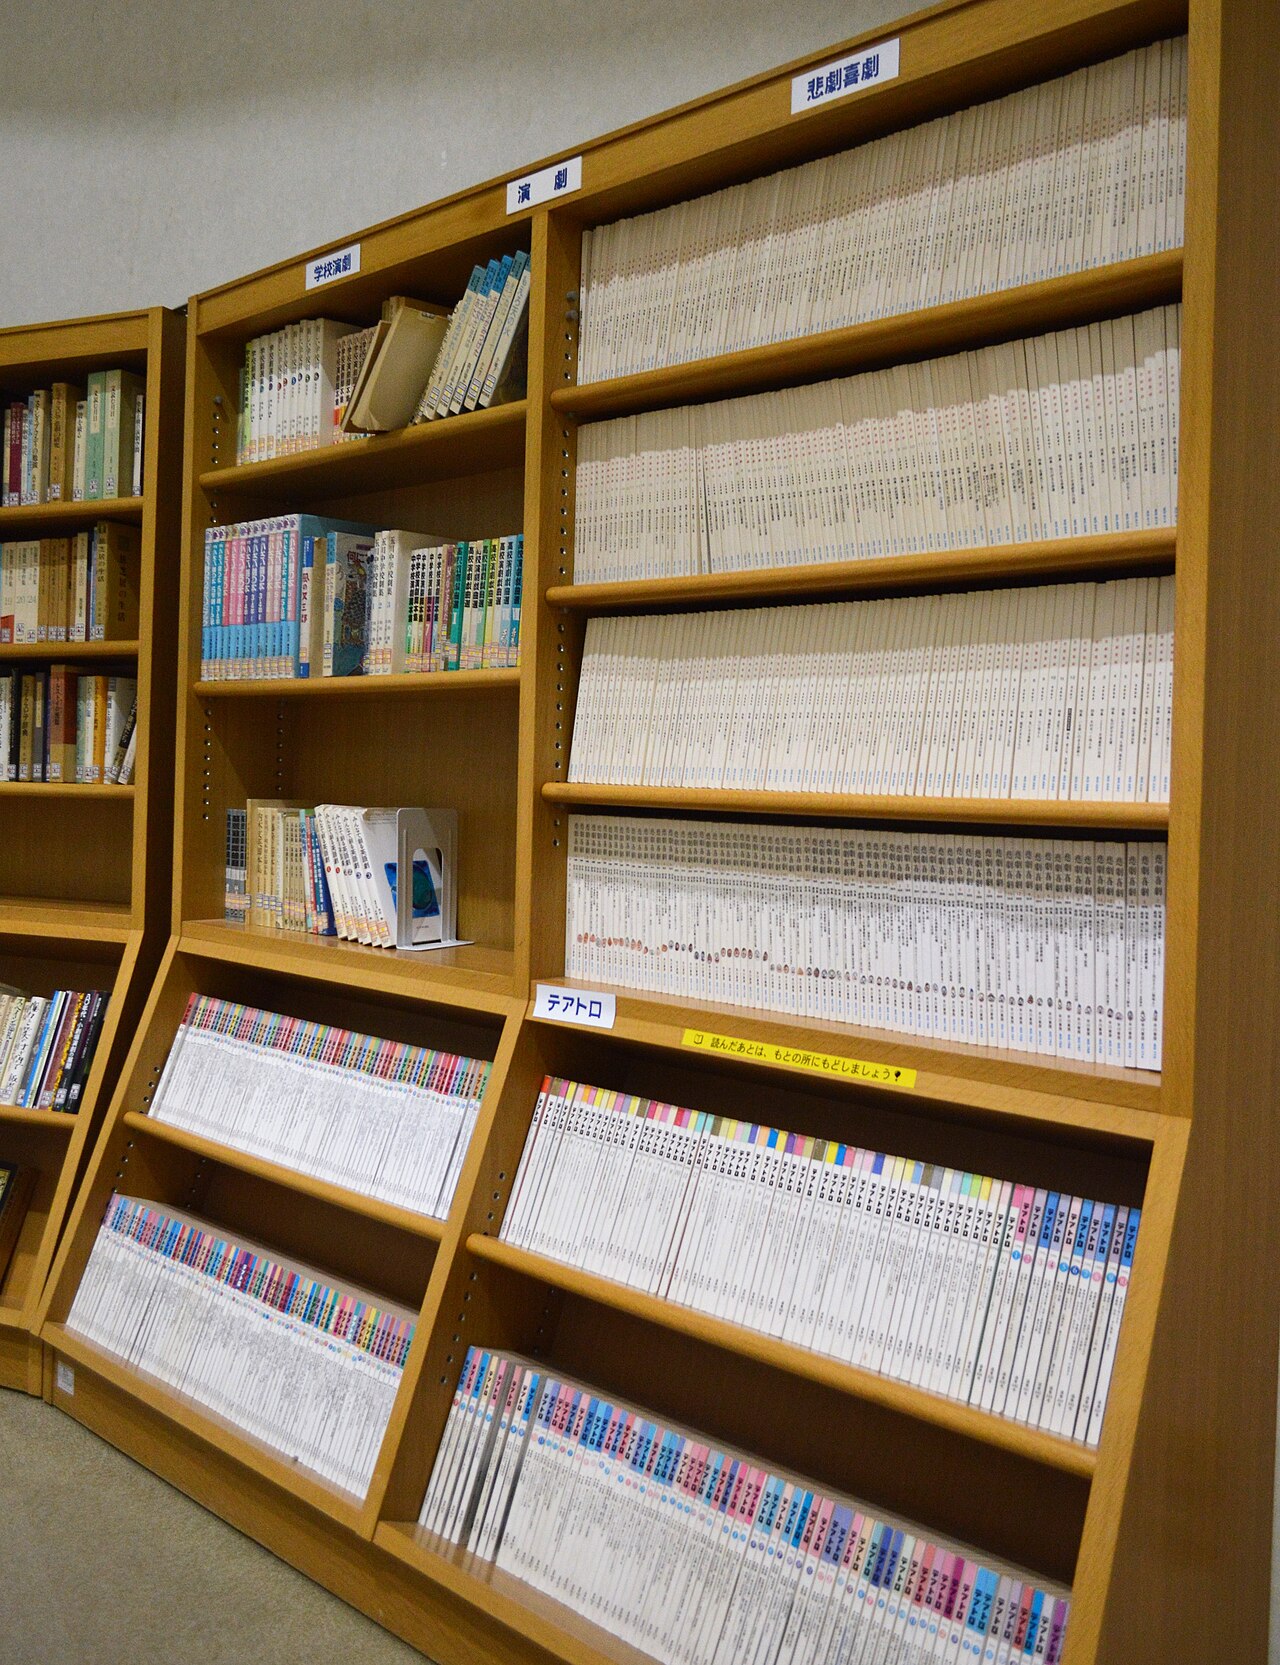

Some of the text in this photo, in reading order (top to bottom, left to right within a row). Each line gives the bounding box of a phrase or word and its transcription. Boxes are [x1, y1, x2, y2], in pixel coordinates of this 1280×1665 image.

[806, 53, 880, 102] 悲劇喜劇
[517, 167, 569, 204] 演 劇
[313, 253, 352, 283] 学校演劇
[547, 993, 603, 1019] テアトロ
[709, 1036, 768, 1059] 読んだあとは、
[533, 1099, 542, 1121] テアトロ
[551, 1103, 560, 1126] テアトロ
[558, 1105, 567, 1129] テアトロ
[574, 1108, 582, 1131] テアトロ
[579, 1111, 588, 1134] テアトロ
[592, 1113, 601, 1137] テアトロ
[599, 1116, 608, 1139] テアトロ
[613, 1119, 622, 1143] テアトロ
[620, 1121, 630, 1145] テアトロ
[639, 1126, 648, 1150] テアトロ
[645, 1127, 654, 1152] テアトロ
[658, 1131, 668, 1156] テアトロ
[666, 1133, 675, 1158] テアトロ
[679, 1137, 689, 1162] テアトロ
[687, 1139, 696, 1165] テアトロ
[703, 1143, 713, 1169] テアトロ
[712, 1144, 721, 1170] テアトロ
[726, 1149, 736, 1175] テアトロ
[734, 1150, 743, 1176] テアトロ
[750, 1154, 760, 1180] テアトロ
[760, 1156, 770, 1182] テアトロ
[778, 1161, 787, 1188] テアトロ
[786, 1164, 796, 1191] テアトロ
[806, 1168, 817, 1196] テアトロ
[819, 1171, 829, 1198] テアトロ
[836, 1175, 846, 1203] テアトロ
[846, 1177, 855, 1204] テアトロ
[865, 1183, 876, 1211] テアトロ
[875, 1186, 885, 1214] テアトロ
[896, 1190, 906, 1218] テアトロ
[904, 1193, 914, 1221] テアトロ
[924, 1198, 934, 1227] テアトロ
[934, 1200, 944, 1229] テアトロ
[1018, 1203, 1029, 1233] テアトロ
[953, 1204, 963, 1233] テアトロ
[962, 1207, 972, 1236] テアトロ
[981, 1211, 992, 1242] テアトロ
[992, 1214, 1003, 1244] テアトロ
[1004, 1217, 1014, 1246] テアトロ
[1029, 1206, 1040, 1236] テアトロ
[1042, 1210, 1052, 1239] テアトロ
[1053, 1211, 1064, 1242] テアトロ
[1065, 1213, 1076, 1244] テアトロ
[1076, 1216, 1087, 1247] テアトロ
[1087, 1219, 1099, 1251] テアトロ
[1098, 1222, 1109, 1253] テアトロ
[1112, 1222, 1124, 1254] テアトロ
[1124, 1227, 1135, 1257] テアトロ
[465, 1363, 477, 1390] テアトロ
[474, 1368, 483, 1391] テアトロ
[517, 1385, 527, 1411] テアトロ
[551, 1400, 562, 1426] テアトロ
[581, 1414, 592, 1440] テアトロ
[604, 1421, 616, 1449] テアトロ
[631, 1435, 643, 1465] テアトロ
[660, 1448, 672, 1478] テアトロ
[683, 1458, 695, 1487] テアトロ
[713, 1470, 726, 1501] テアトロ
[739, 1483, 752, 1514] テアトロ
[775, 1497, 788, 1529] テアトロ
[803, 1510, 818, 1543] テアトロ
[843, 1531, 856, 1563] テアトロ
[883, 1551, 896, 1585] テアトロ
[914, 1567, 928, 1601] テアトロ
[955, 1584, 969, 1619] テアトロ
[990, 1597, 1004, 1634] テアトロ
[1035, 1618, 1048, 1653] テアトロ
